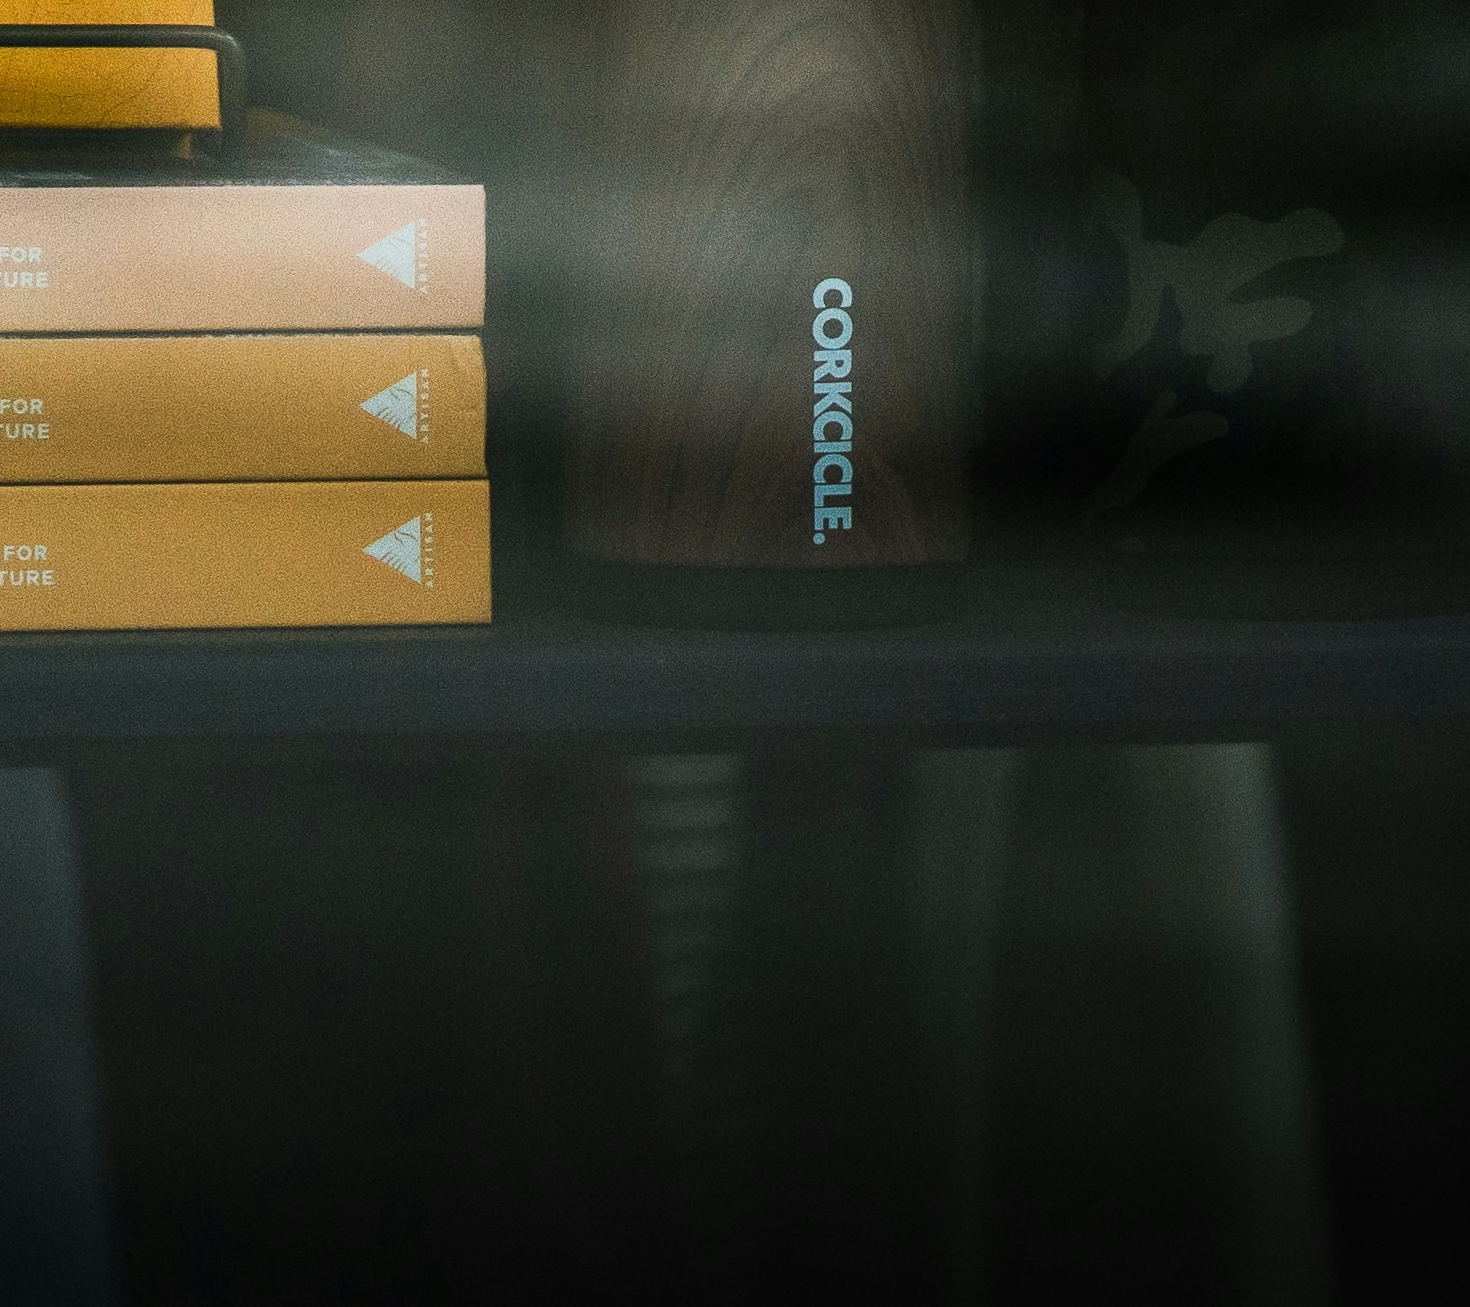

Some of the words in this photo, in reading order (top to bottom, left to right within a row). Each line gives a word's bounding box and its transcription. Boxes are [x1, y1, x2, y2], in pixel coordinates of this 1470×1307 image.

[0, 398, 44, 415] FOR
[813, 277, 853, 544] CORKCICLE.
[3, 544, 49, 561] FOR
